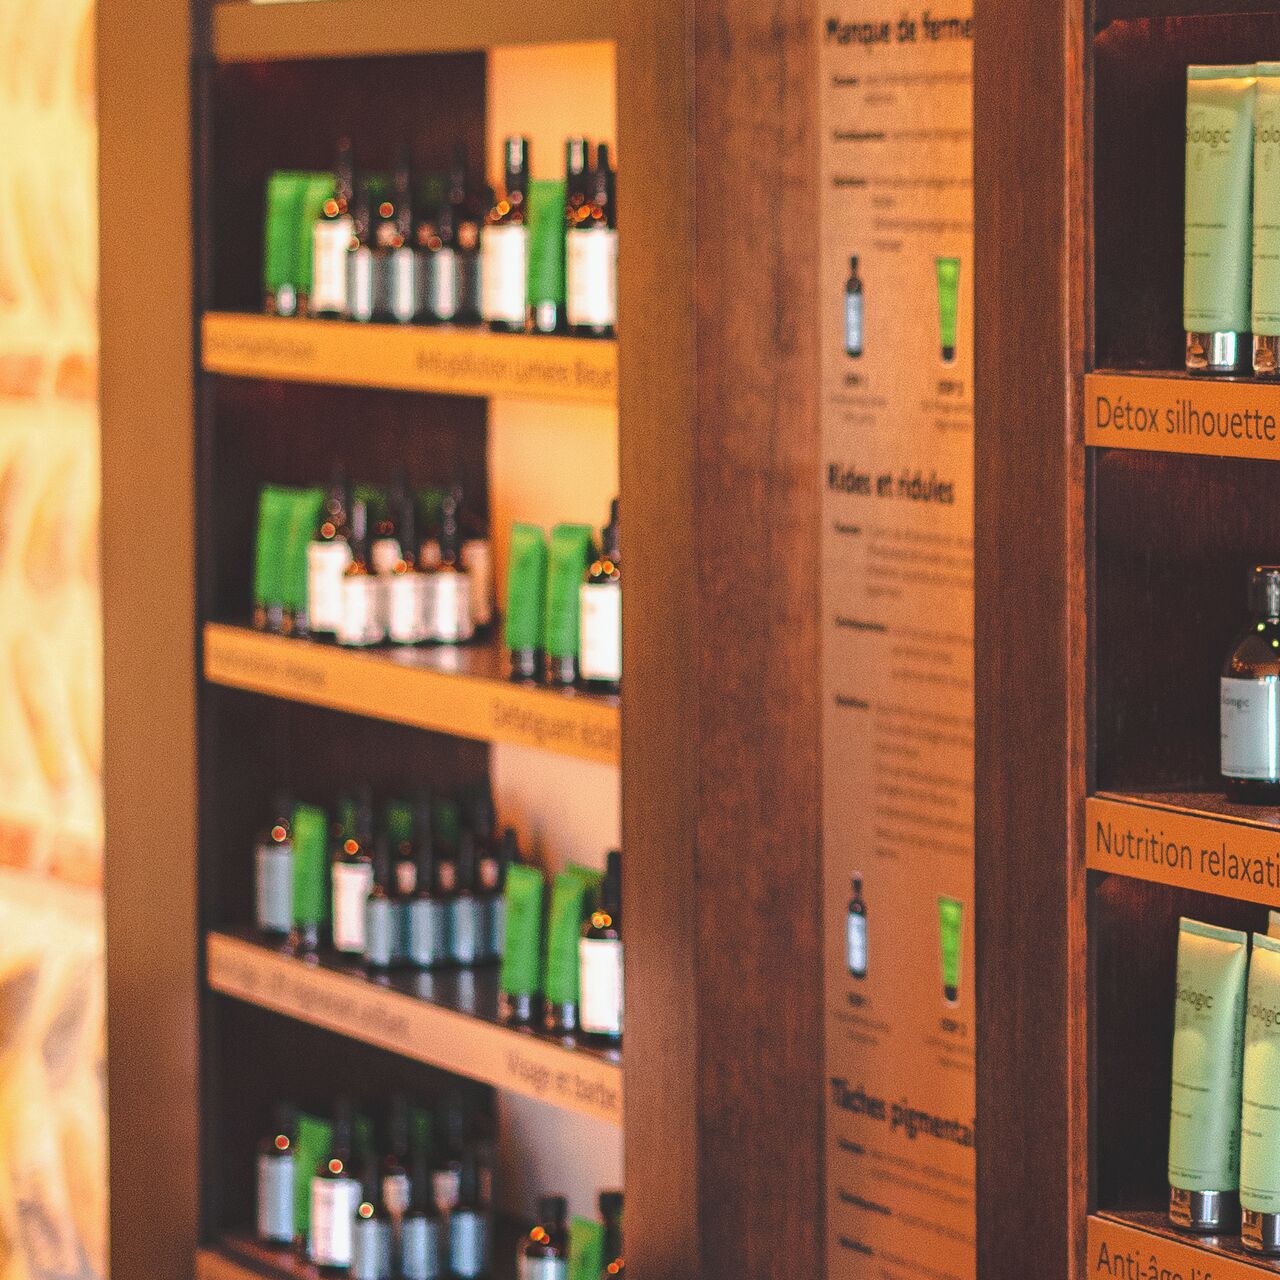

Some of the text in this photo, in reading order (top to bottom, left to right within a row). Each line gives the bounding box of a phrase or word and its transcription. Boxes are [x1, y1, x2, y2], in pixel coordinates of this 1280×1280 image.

[1096, 396, 1160, 433] Détox
[1165, 399, 1277, 441] silhouette
[1095, 820, 1193, 871] Nutrition
